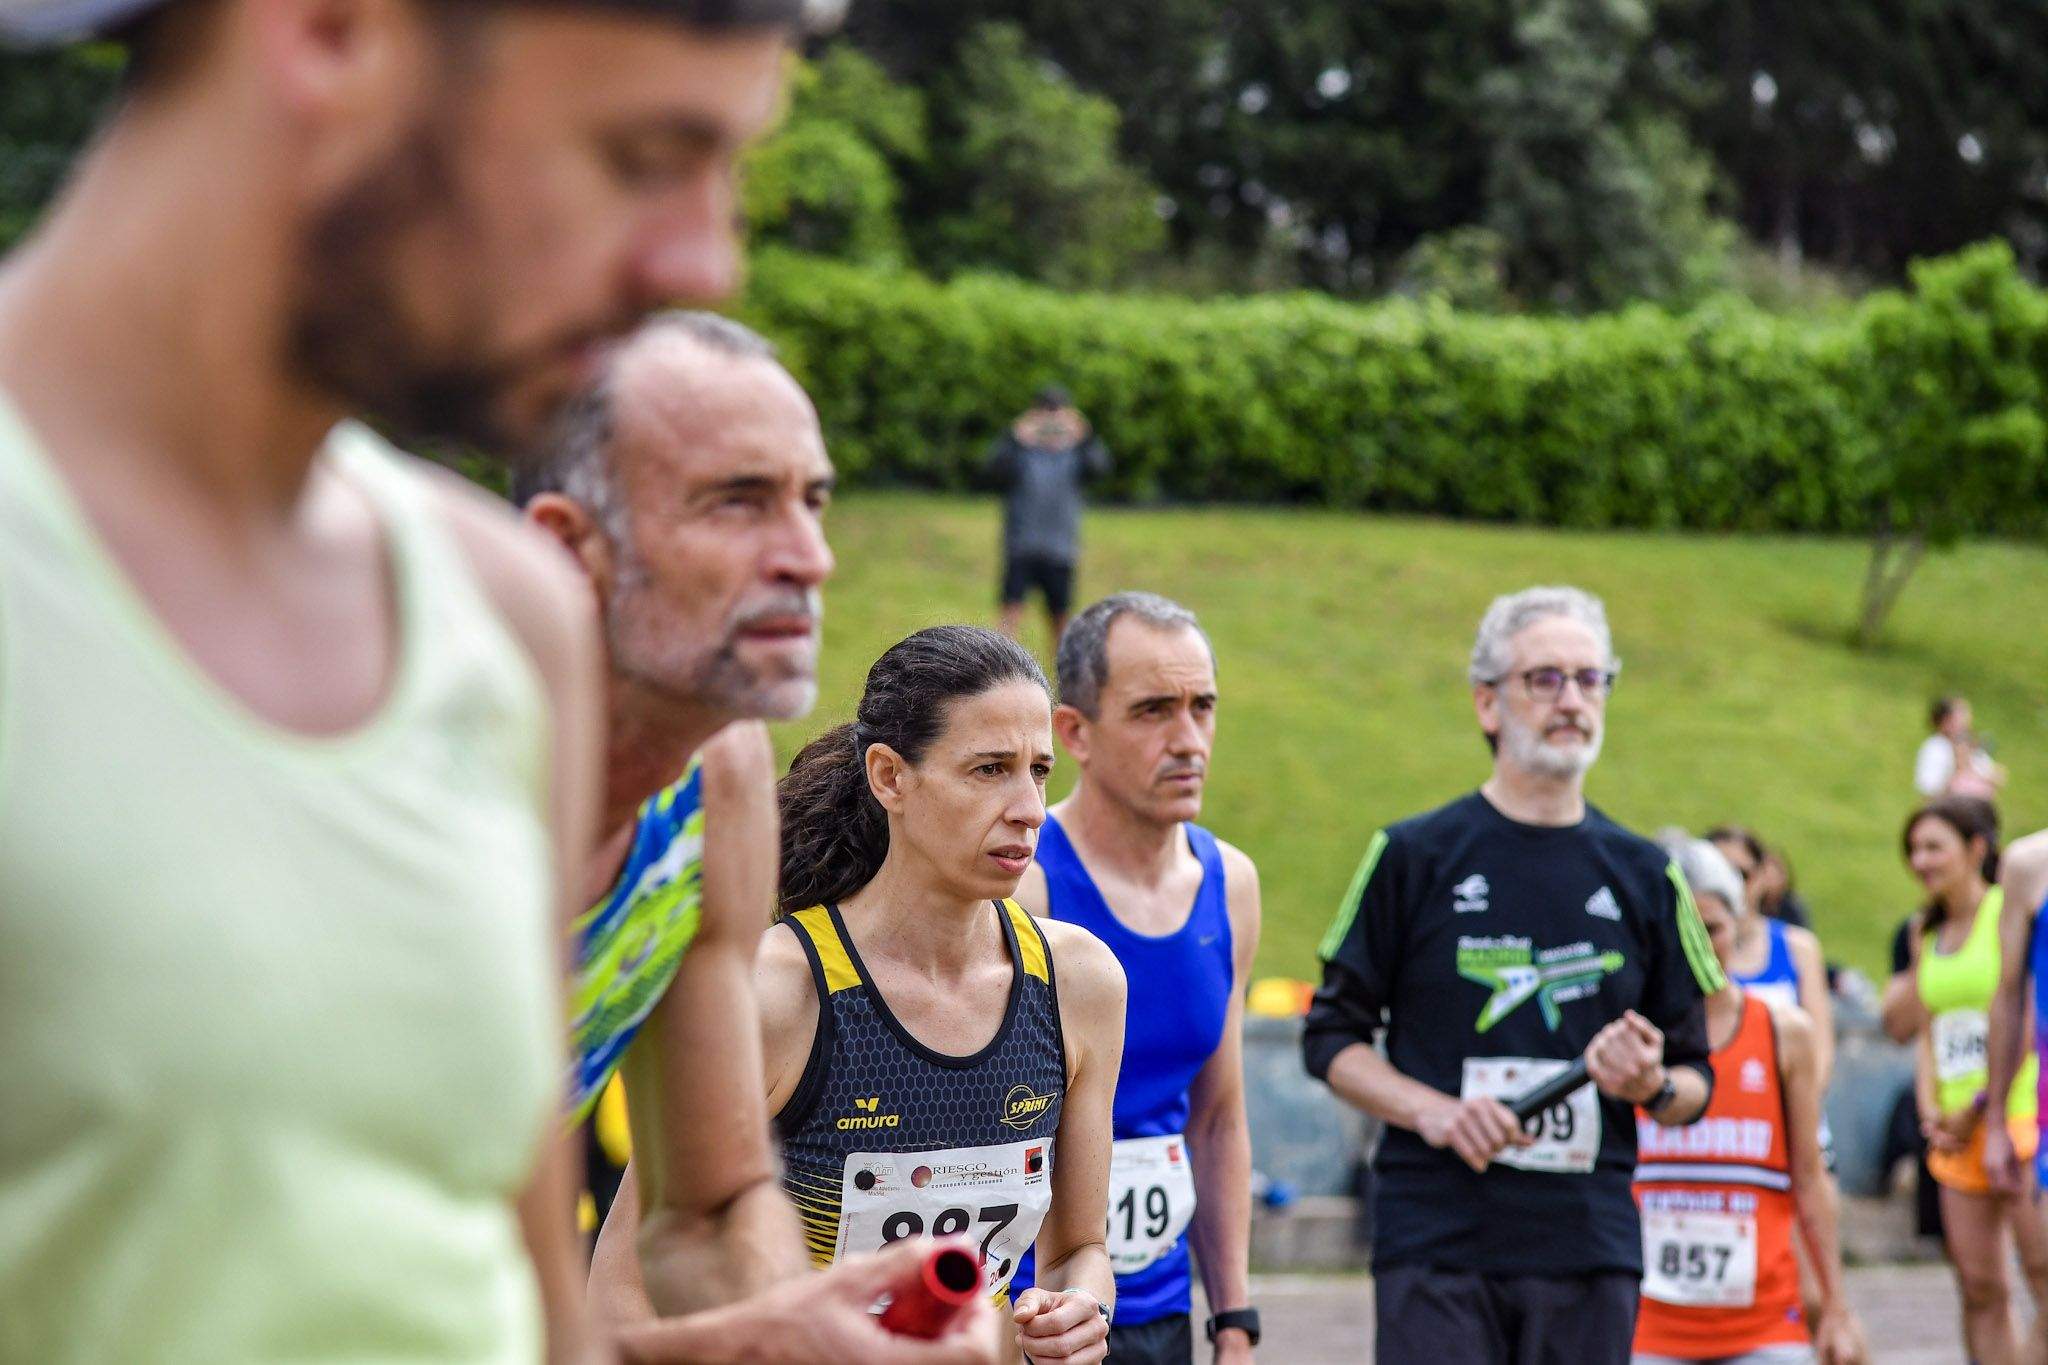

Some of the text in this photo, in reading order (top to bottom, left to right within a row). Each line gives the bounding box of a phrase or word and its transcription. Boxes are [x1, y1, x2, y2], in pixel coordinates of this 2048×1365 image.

[1010, 1098, 1049, 1115] SPRINT
[837, 1114, 900, 1130] amura
[1499, 1097, 1574, 1141] 09
[933, 1163, 987, 1174] RIESGO
[972, 1168, 1018, 1181] gestión
[1106, 1187, 1169, 1240] 19
[1659, 1241, 1732, 1282] 857
